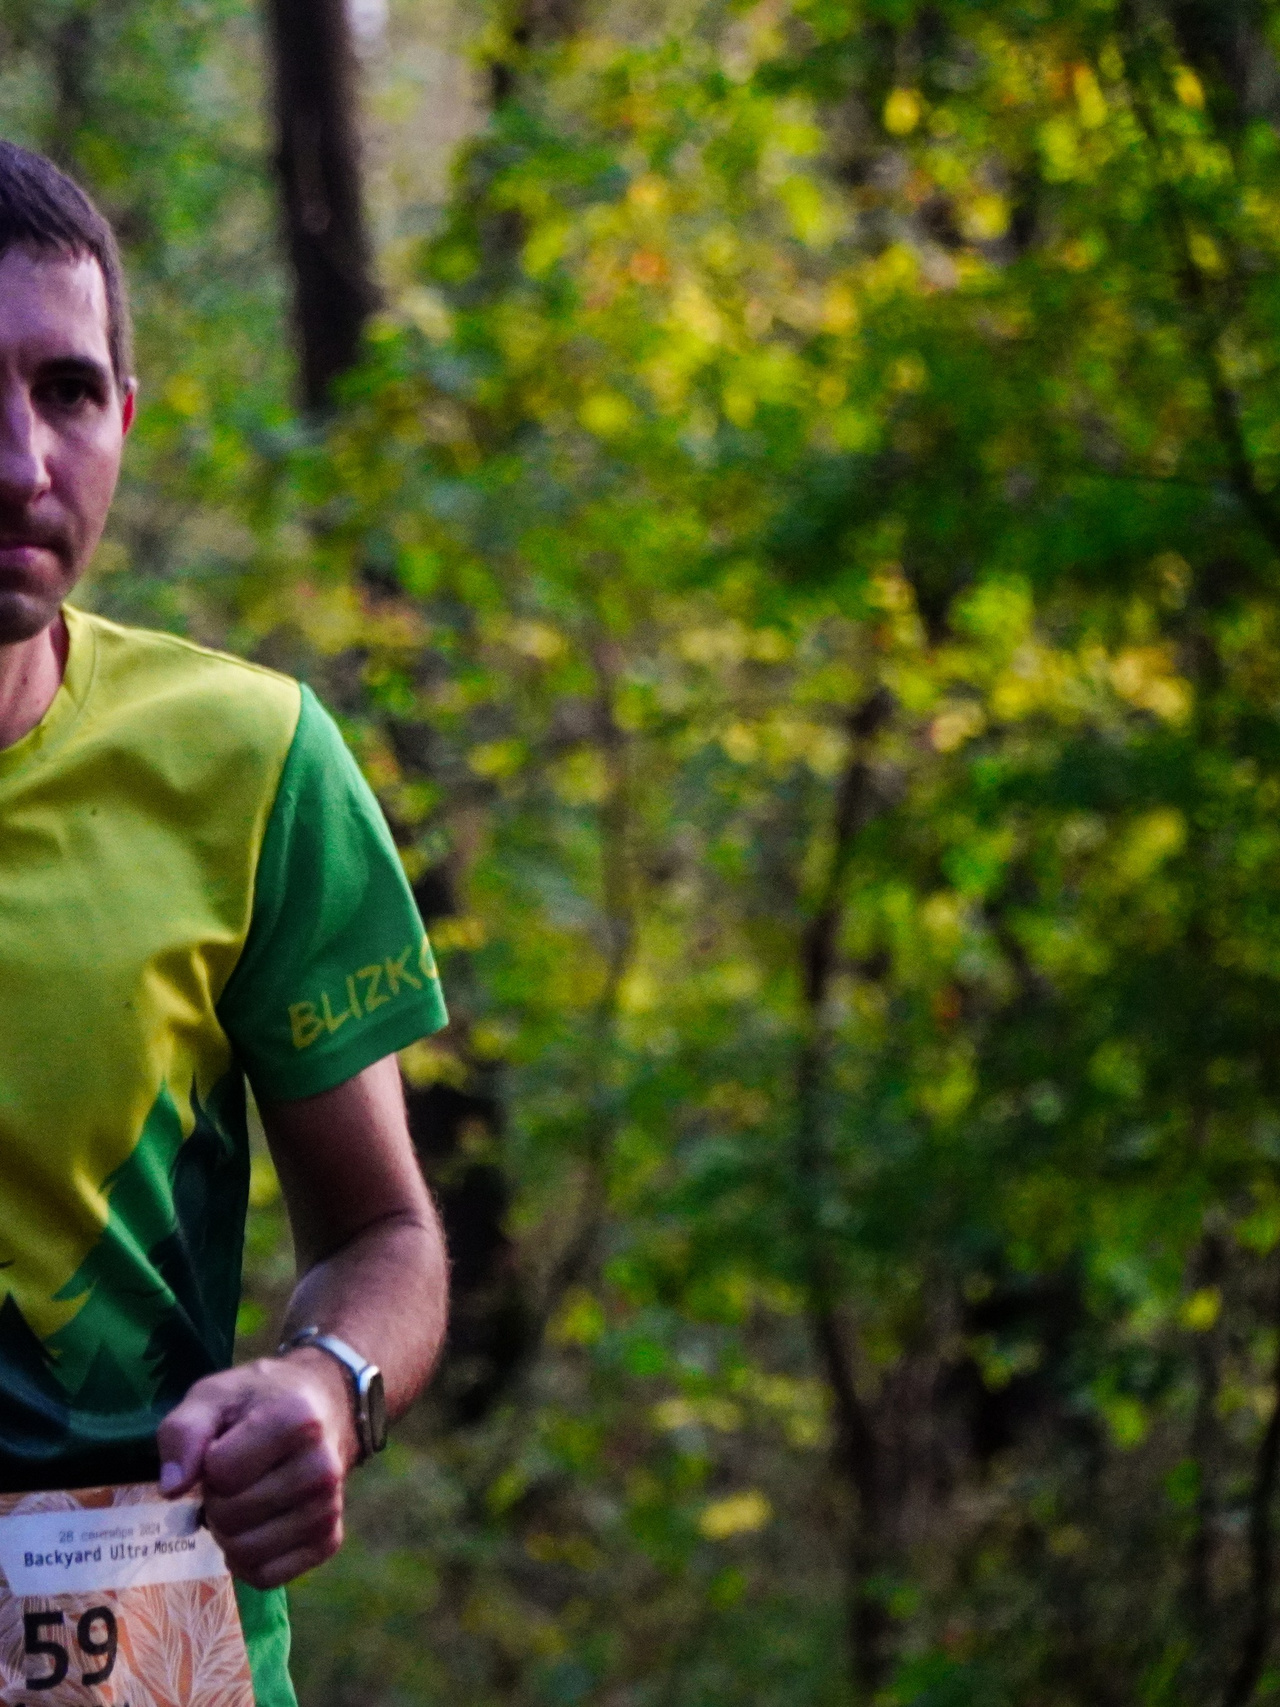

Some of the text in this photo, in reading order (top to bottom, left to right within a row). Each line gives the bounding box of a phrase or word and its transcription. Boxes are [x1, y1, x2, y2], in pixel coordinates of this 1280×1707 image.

[23, 1547, 102, 1569] Backyard
[110, 1544, 148, 1561] Ultra
[23, 1605, 119, 1692] 59
